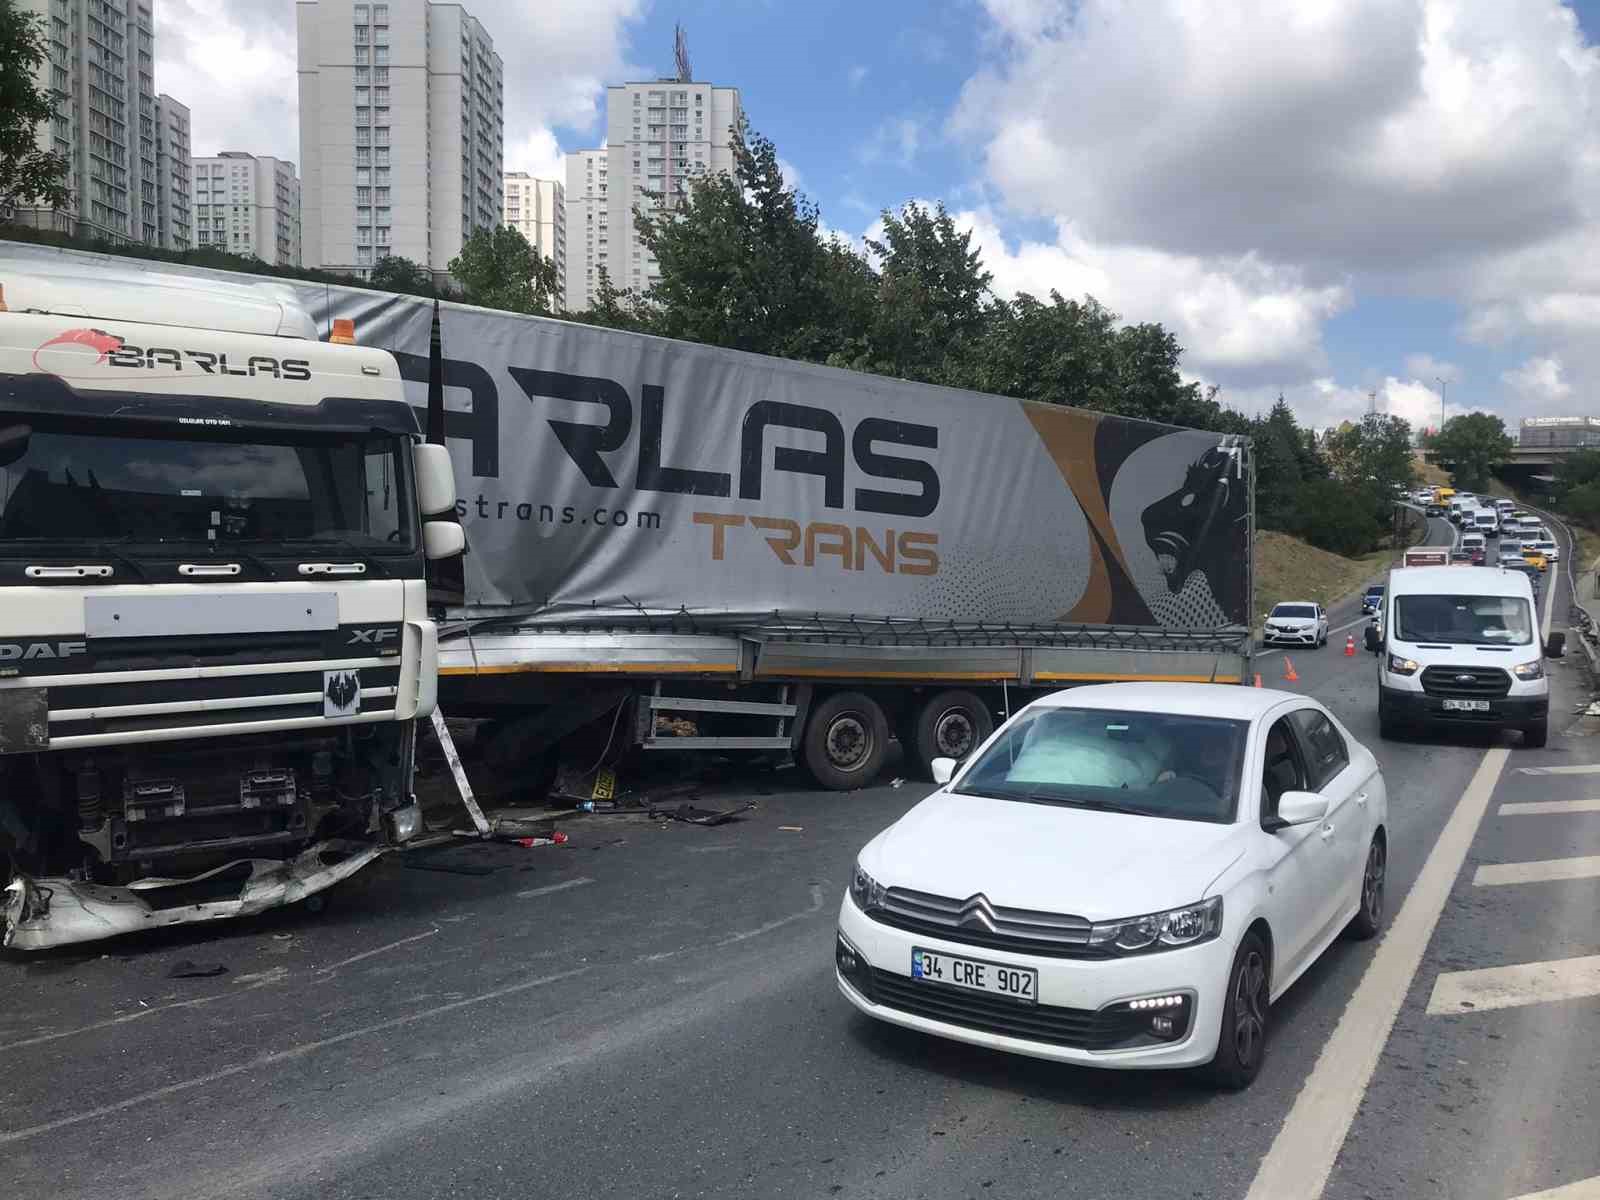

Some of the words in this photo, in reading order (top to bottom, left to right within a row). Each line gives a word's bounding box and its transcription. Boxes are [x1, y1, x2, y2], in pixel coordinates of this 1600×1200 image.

[107, 344, 312, 381] BARLAS
[391, 350, 941, 518] ARLAS
[455, 494, 661, 529] strans.com
[692, 511, 940, 577] TRANS
[0, 641, 87, 660] DAF
[346, 628, 398, 645] XF
[922, 954, 943, 979] 34
[952, 960, 986, 988] CRE
[997, 969, 1033, 996] 902
